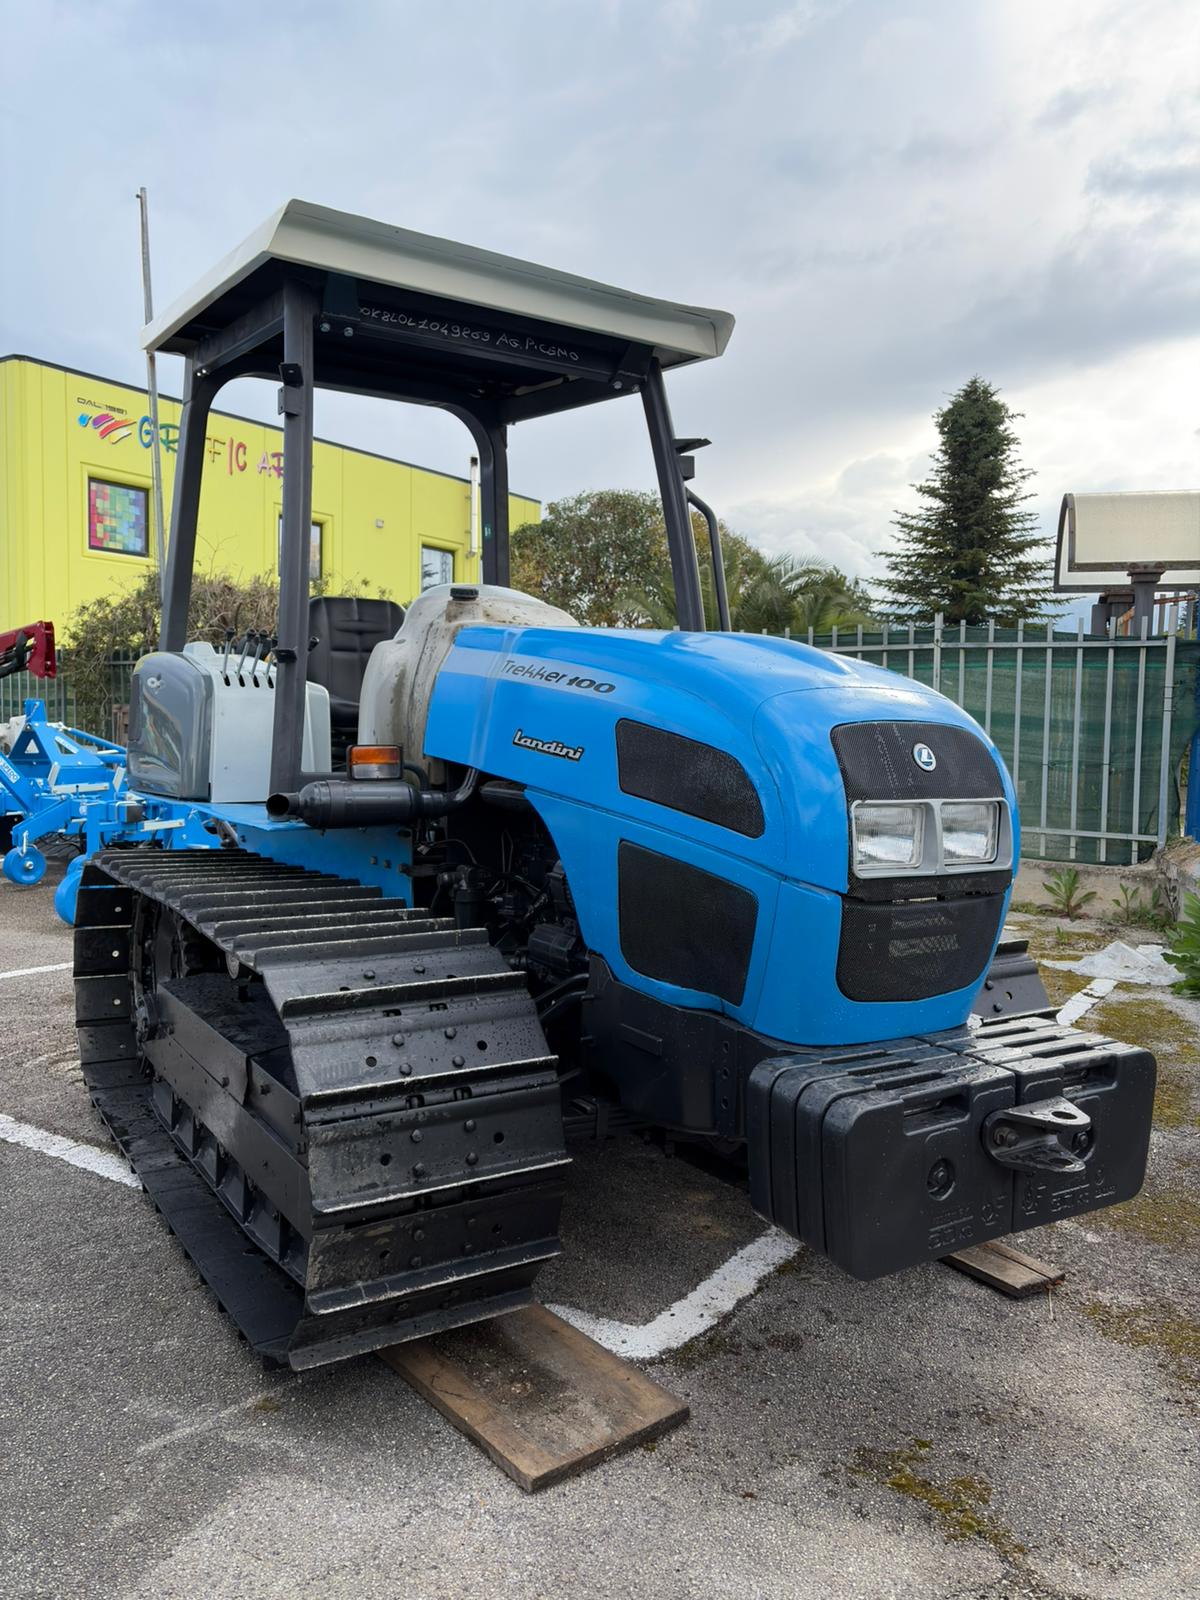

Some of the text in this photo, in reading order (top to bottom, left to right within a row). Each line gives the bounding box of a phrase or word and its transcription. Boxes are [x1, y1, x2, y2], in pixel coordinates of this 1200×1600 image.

[501, 660, 617, 694] Trekker 100
[512, 728, 585, 762] Landini
